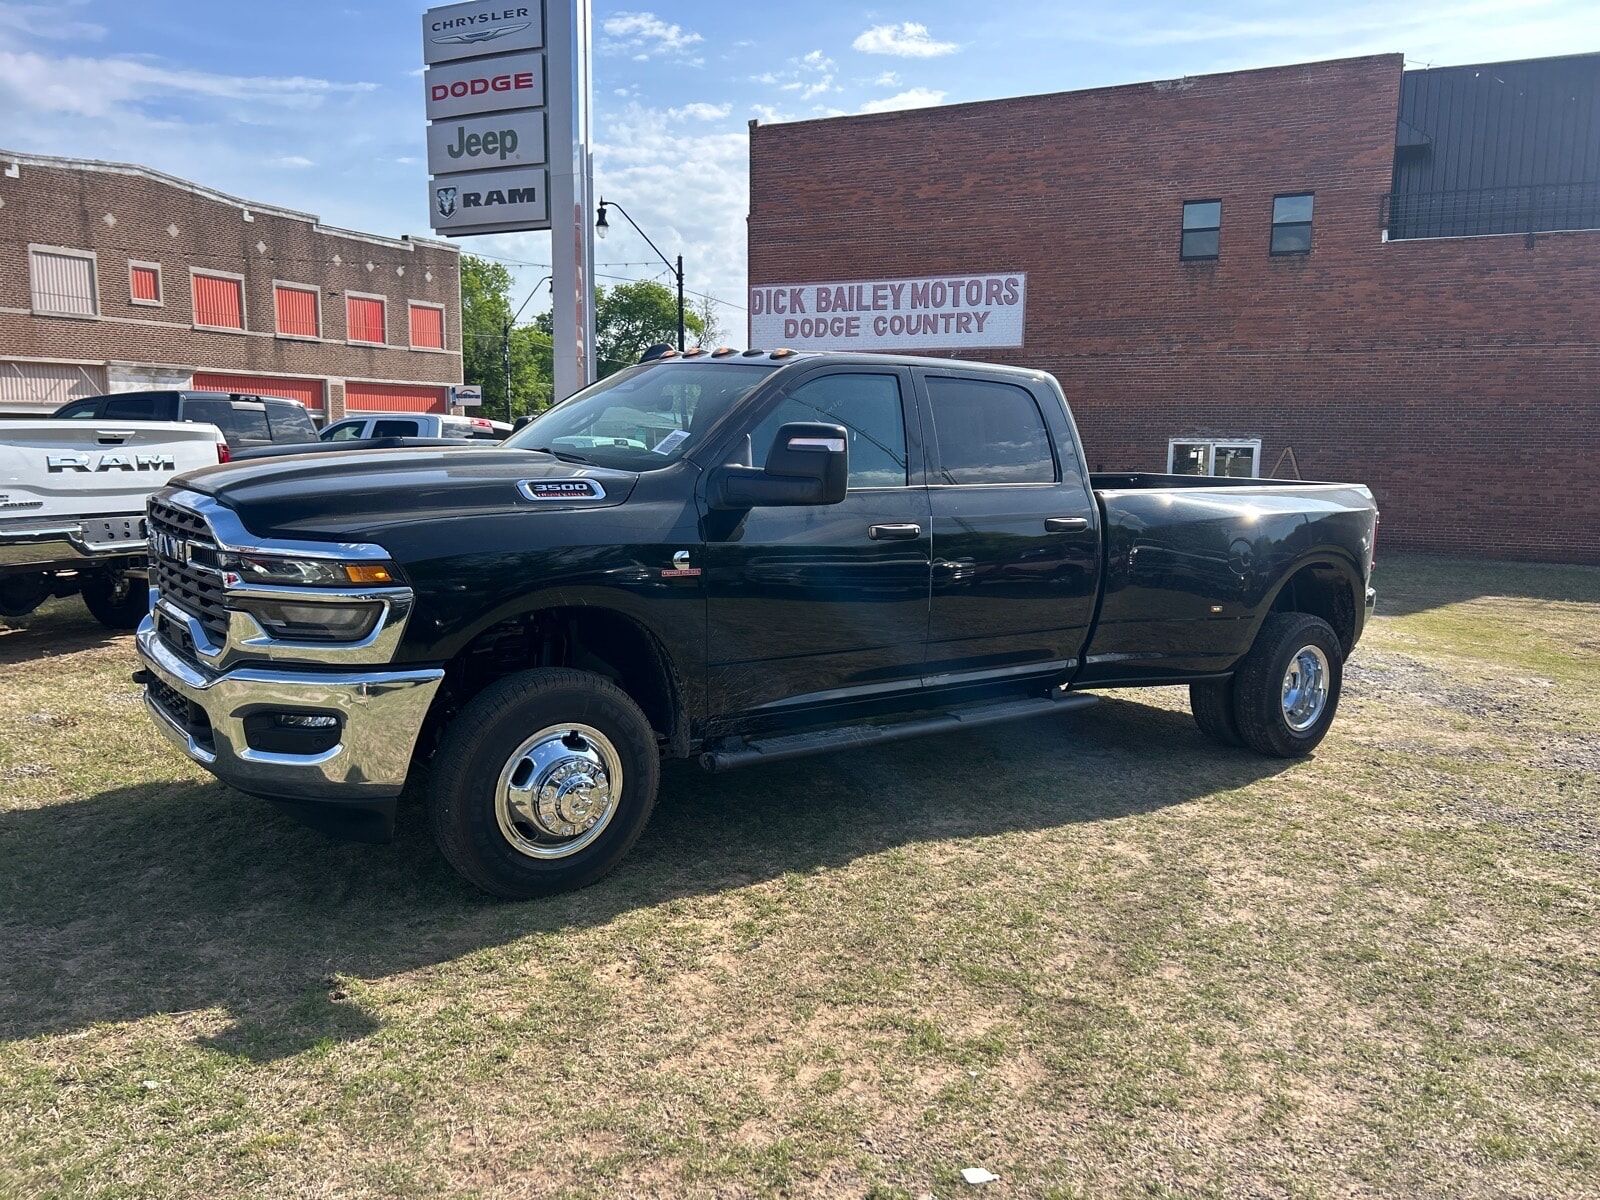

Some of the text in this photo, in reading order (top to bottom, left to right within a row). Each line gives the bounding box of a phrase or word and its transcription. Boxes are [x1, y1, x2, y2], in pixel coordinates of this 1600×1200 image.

[431, 7, 529, 32] CHRYSLER
[431, 72, 534, 101] DODGE
[447, 126, 518, 160] Jeep
[462, 187, 536, 208] RAM
[751, 277, 1020, 315] DICK BAILEY MOTORS
[784, 311, 991, 339] DODGE COUNTRY
[46, 454, 176, 473] RAM
[534, 483, 588, 491] 3500
